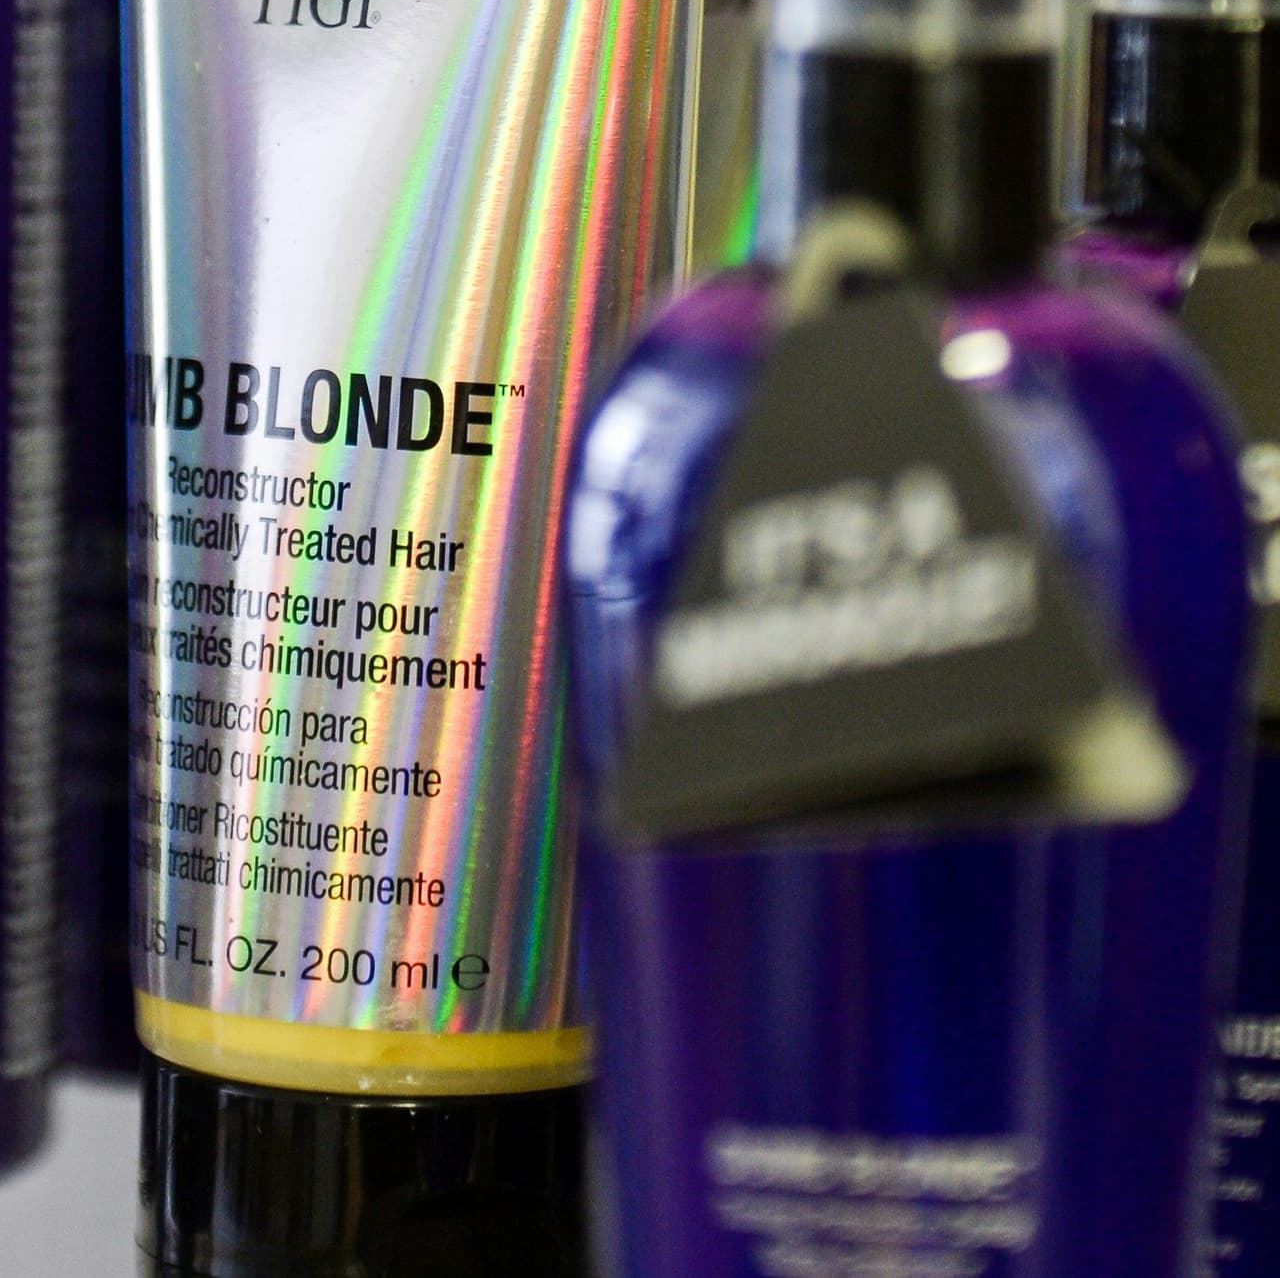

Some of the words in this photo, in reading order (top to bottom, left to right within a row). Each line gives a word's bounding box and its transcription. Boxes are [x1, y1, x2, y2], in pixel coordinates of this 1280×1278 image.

[168, 455, 352, 513] Reconstructor
[257, 517, 378, 568] Treated
[390, 529, 465, 573] Hair
[355, 599, 439, 639] pour
[168, 624, 233, 668] raités
[240, 634, 488, 691] chimiquement
[301, 710, 369, 747] para
[155, 730, 222, 777] tatado
[230, 745, 443, 798] químicamente
[214, 801, 389, 858] Ricostituente
[239, 855, 447, 908] chimicamente
[175, 924, 214, 967] FL.
[226, 934, 287, 978] OZ.
[301, 945, 376, 986] 200
[391, 954, 440, 991] ml
